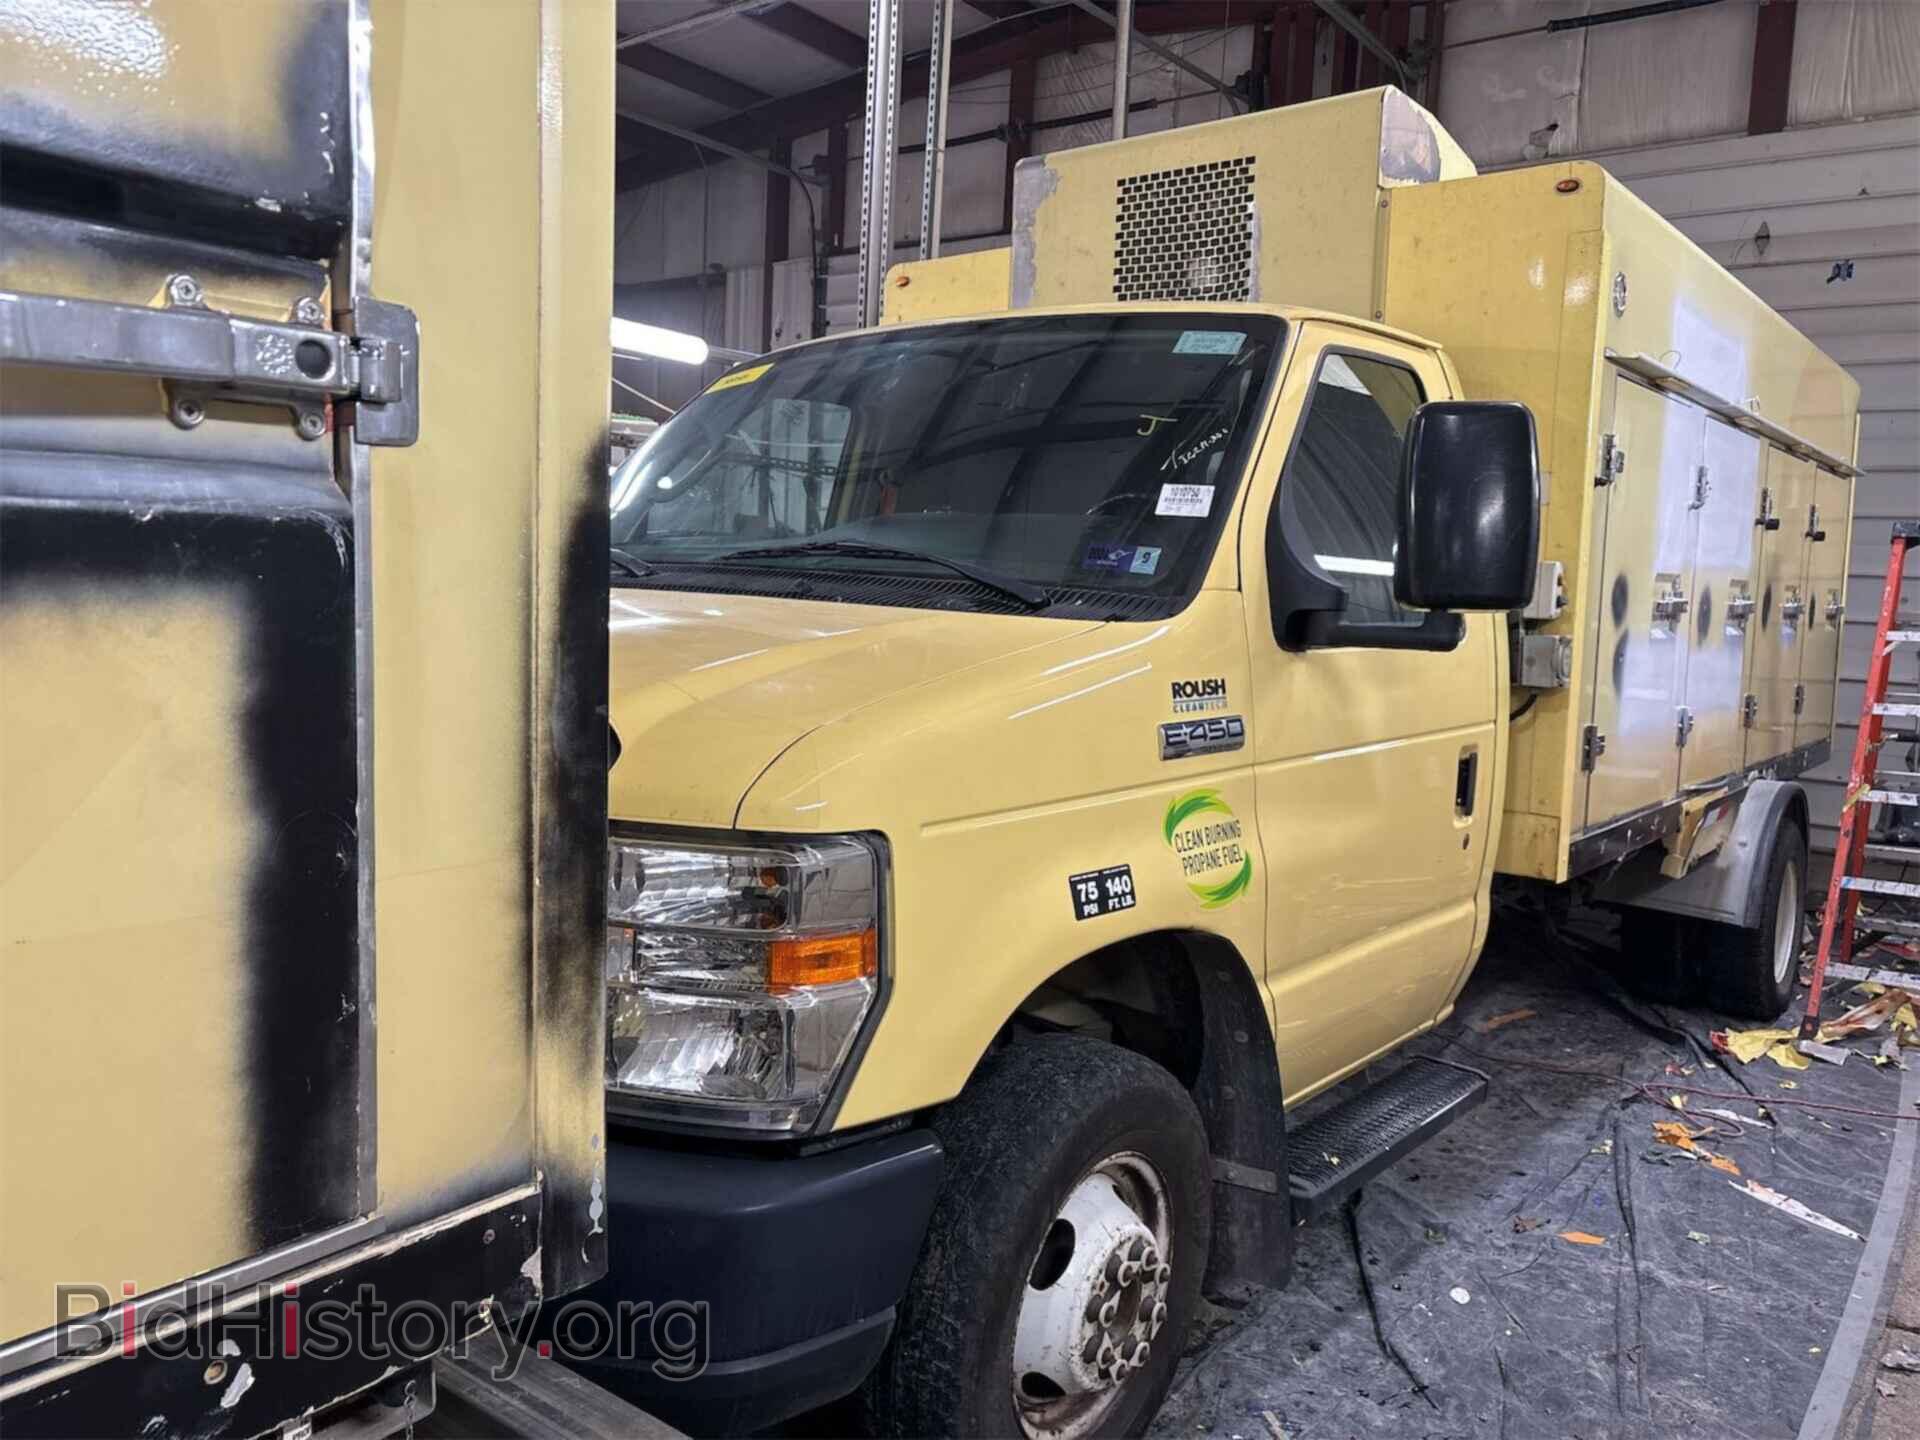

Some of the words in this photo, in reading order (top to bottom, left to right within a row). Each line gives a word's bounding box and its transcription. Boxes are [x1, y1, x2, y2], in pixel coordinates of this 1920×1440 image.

[1171, 678, 1226, 699] ROUSH
[1173, 700, 1228, 713] CLEANTECH
[1174, 829, 1204, 853] CLEAN
[1204, 819, 1242, 846] BURNING
[1182, 847, 1222, 876] PROPANE
[1221, 843, 1243, 866] FUEL
[1076, 880, 1099, 902] 75
[1105, 874, 1132, 897] 140
[1083, 902, 1099, 916] PSI
[1108, 897, 1120, 911] FT.
